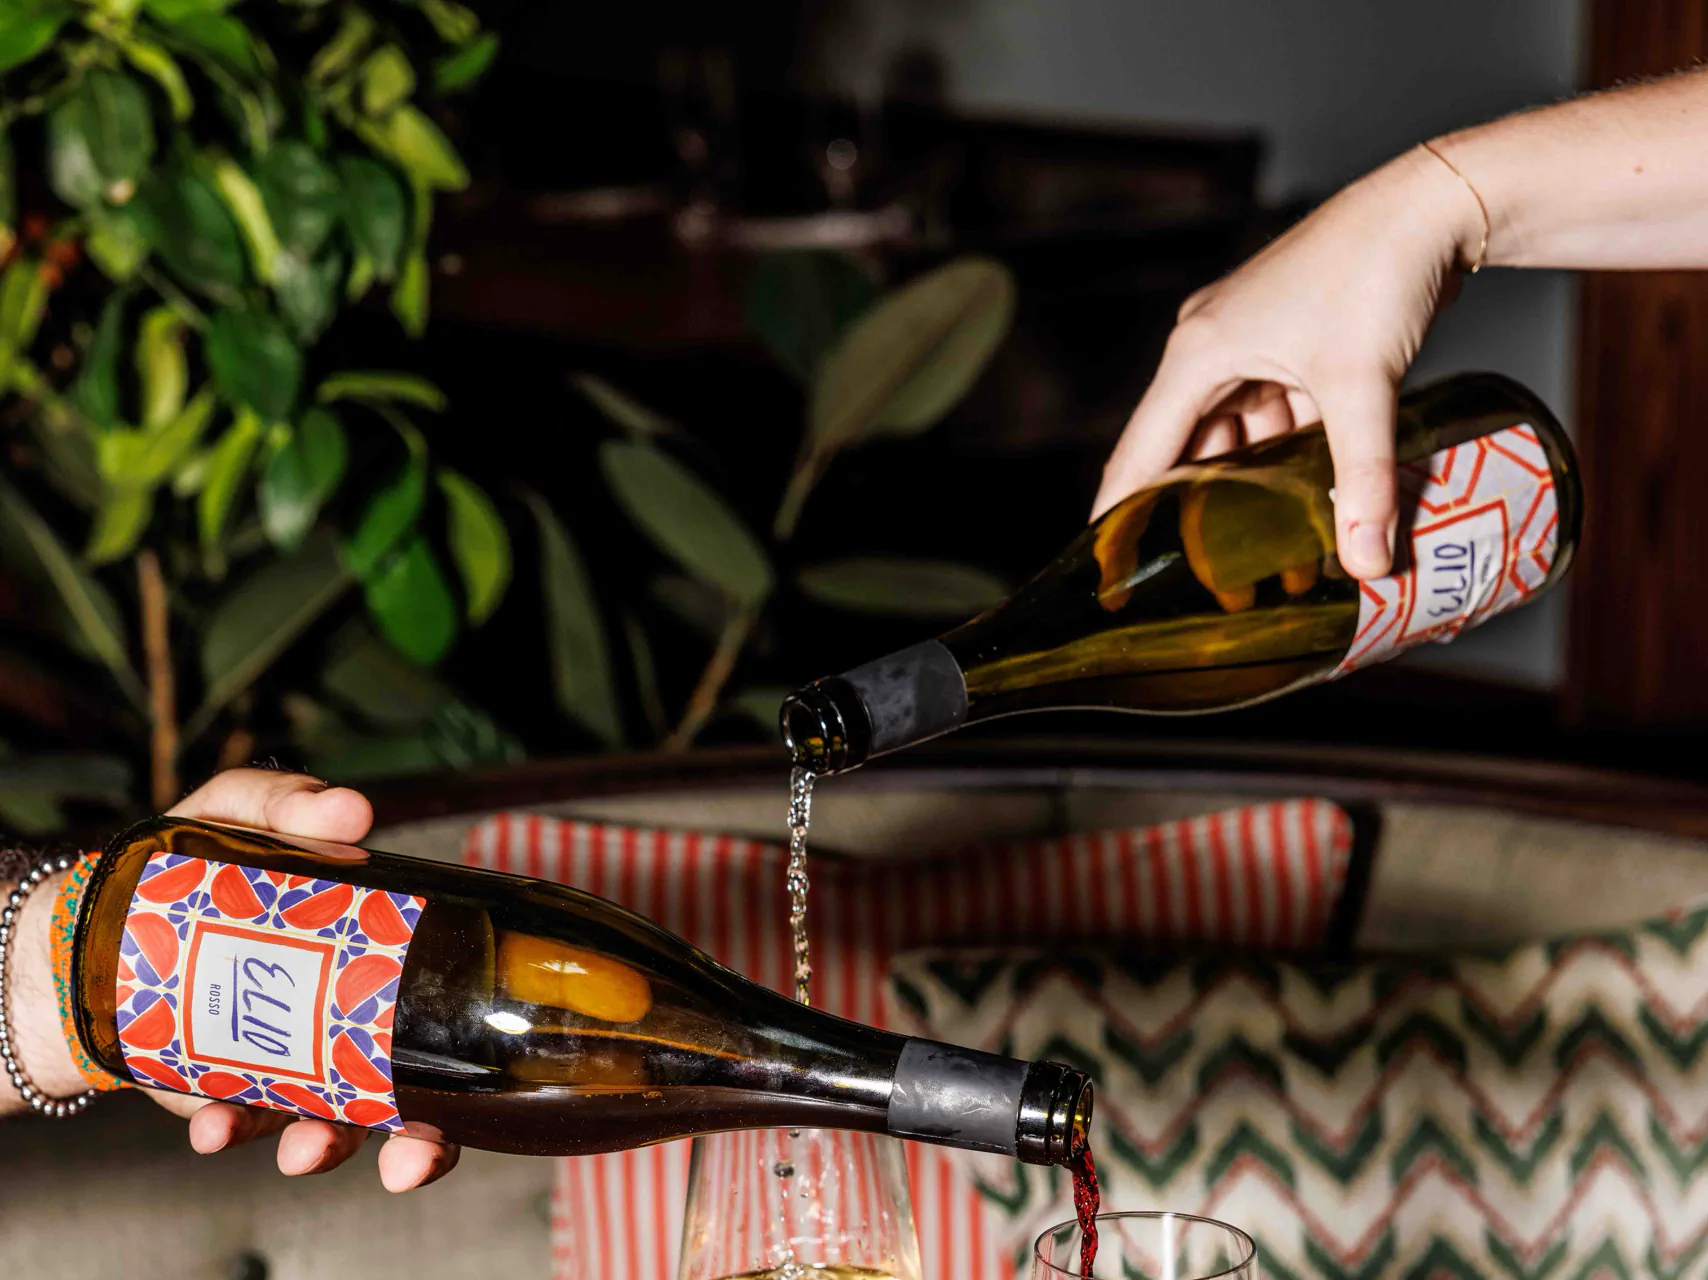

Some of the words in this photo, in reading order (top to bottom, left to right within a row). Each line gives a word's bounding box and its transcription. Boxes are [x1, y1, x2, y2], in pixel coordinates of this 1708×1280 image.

[1427, 543, 1468, 617] ELIO
[208, 983, 221, 1015] ROSSO
[242, 957, 296, 1057] ELIO
